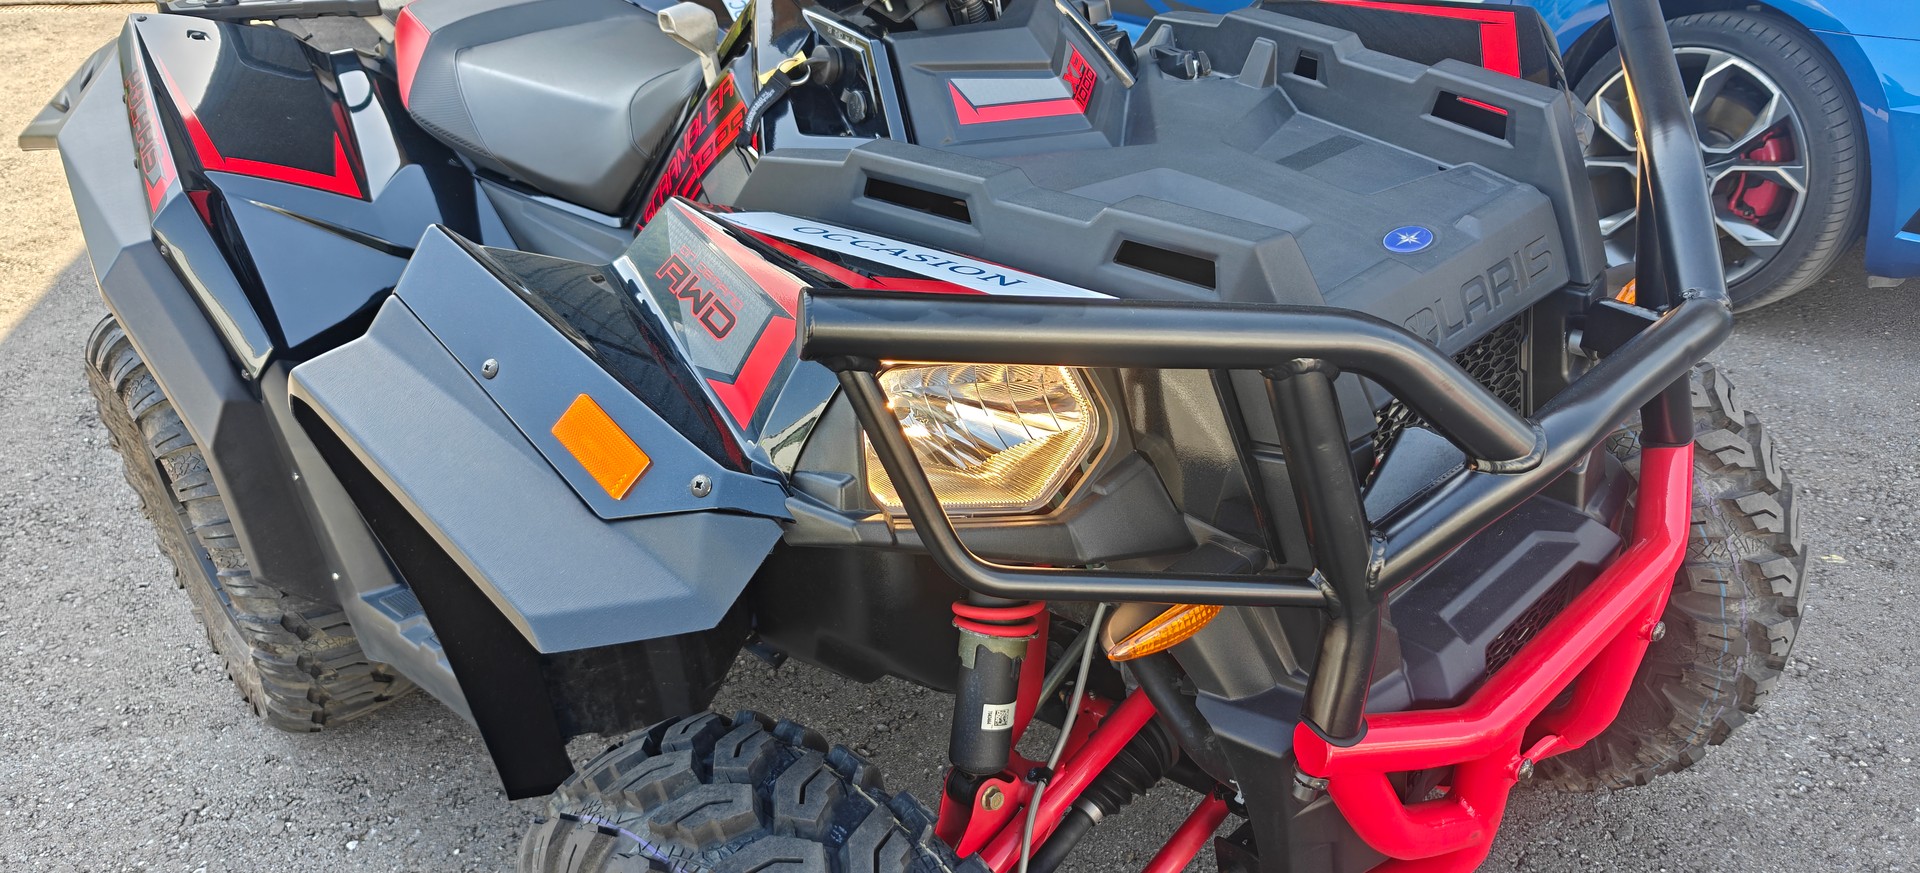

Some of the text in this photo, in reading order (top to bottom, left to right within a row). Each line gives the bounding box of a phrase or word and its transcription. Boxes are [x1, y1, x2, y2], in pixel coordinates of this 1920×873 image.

[1062, 49, 1086, 96] XP
[1075, 67, 1095, 108] 1000
[125, 70, 164, 175] POLARIS
[643, 72, 735, 224] SCRAMBLER
[696, 260, 744, 312] DEMAND
[792, 225, 1028, 287] OCCASION
[1401, 234, 1553, 348] OLARIS
[655, 253, 738, 342] AWD
